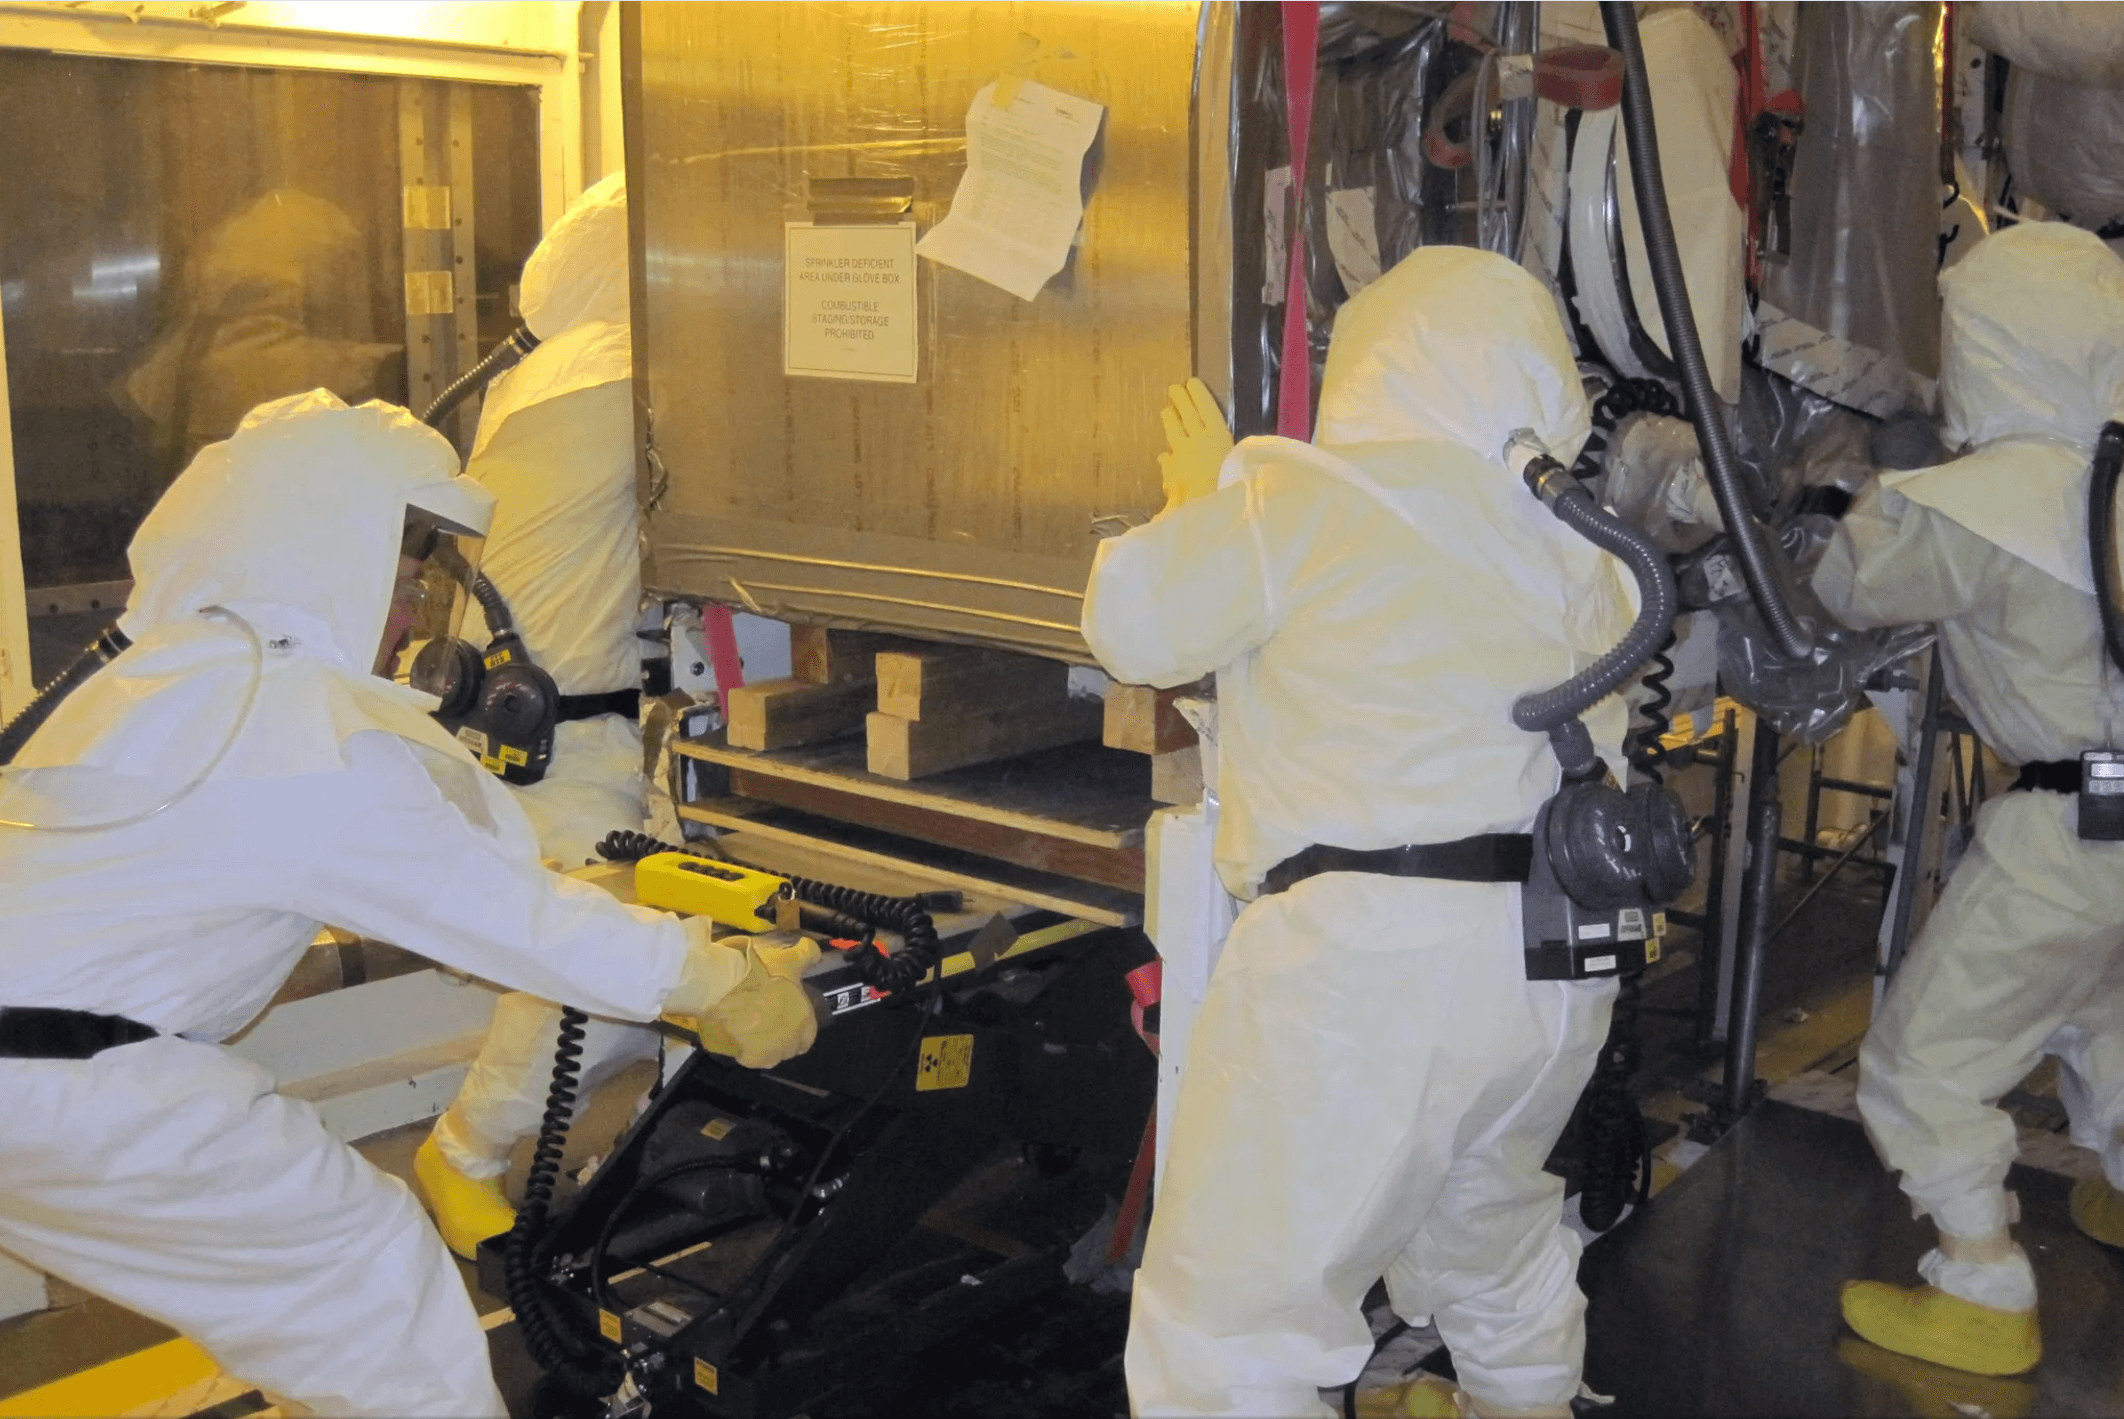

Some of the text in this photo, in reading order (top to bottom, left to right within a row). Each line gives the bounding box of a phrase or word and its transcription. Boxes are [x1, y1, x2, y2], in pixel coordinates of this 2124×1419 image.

[805, 258, 894, 269] SPRINKLER DEFICIENT
[799, 271, 820, 282] AREA
[821, 272, 850, 283] UNDER
[852, 272, 880, 284] GLOVE
[821, 300, 879, 312] COMBUSTIBLE
[812, 313, 890, 327] STAGING/STORAGE
